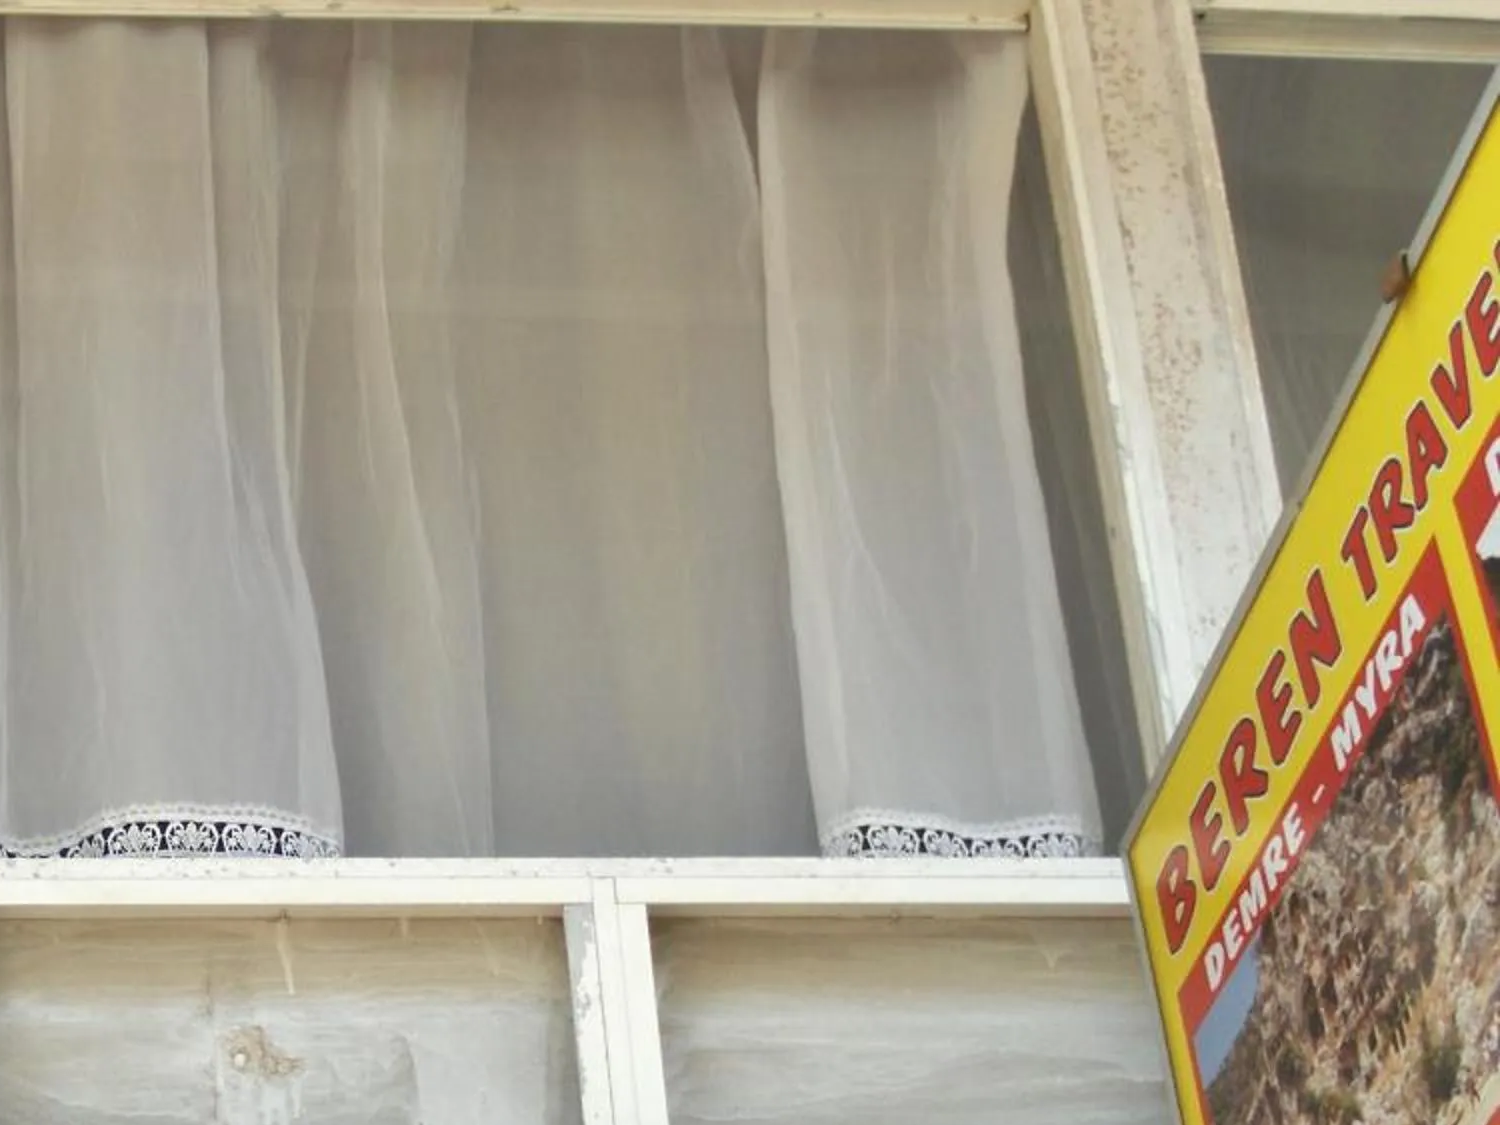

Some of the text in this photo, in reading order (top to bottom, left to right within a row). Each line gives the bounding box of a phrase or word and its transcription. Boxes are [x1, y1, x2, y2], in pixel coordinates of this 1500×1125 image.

[1155, 239, 1500, 957] BEREN TRAVE
[1204, 809, 1307, 994] DEMRE
[1329, 592, 1426, 772] MYRA
